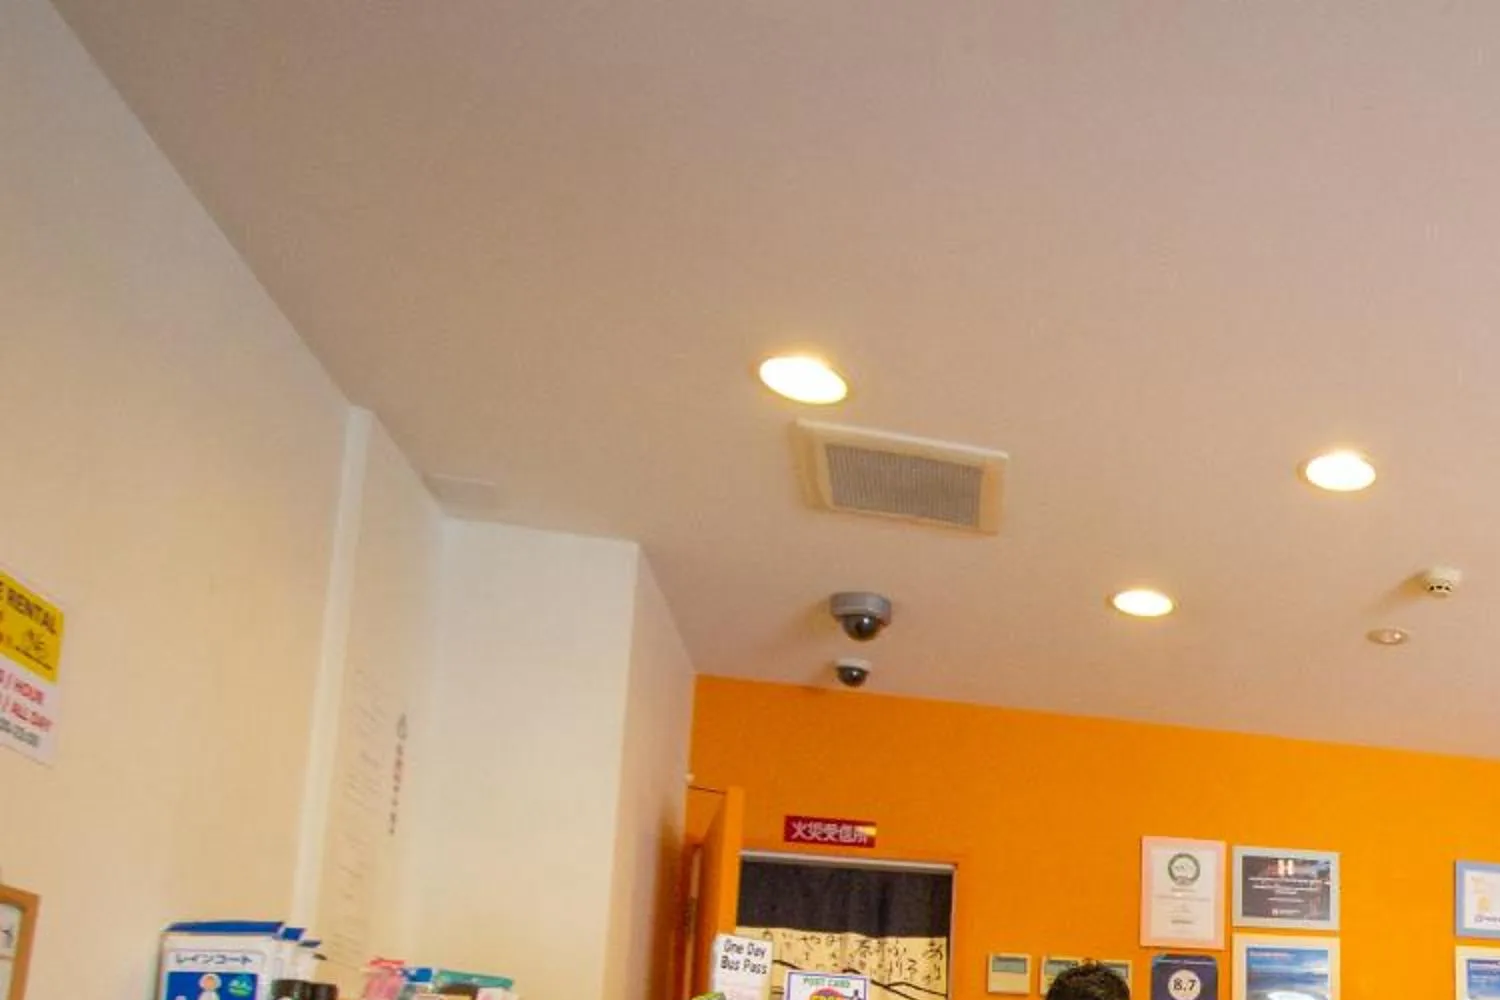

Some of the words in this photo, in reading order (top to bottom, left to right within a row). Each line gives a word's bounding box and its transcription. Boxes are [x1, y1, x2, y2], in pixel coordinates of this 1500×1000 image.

[8, 588, 57, 635] RENTAL
[723, 939, 744, 953] One
[747, 942, 766, 958] Day
[175, 954, 254, 966] レインコート
[720, 956, 740, 971] Bus
[743, 958, 768, 974] Pass
[803, 976, 826, 986] POST
[828, 978, 850, 989] CARD
[1172, 978, 1197, 993] 8.7
